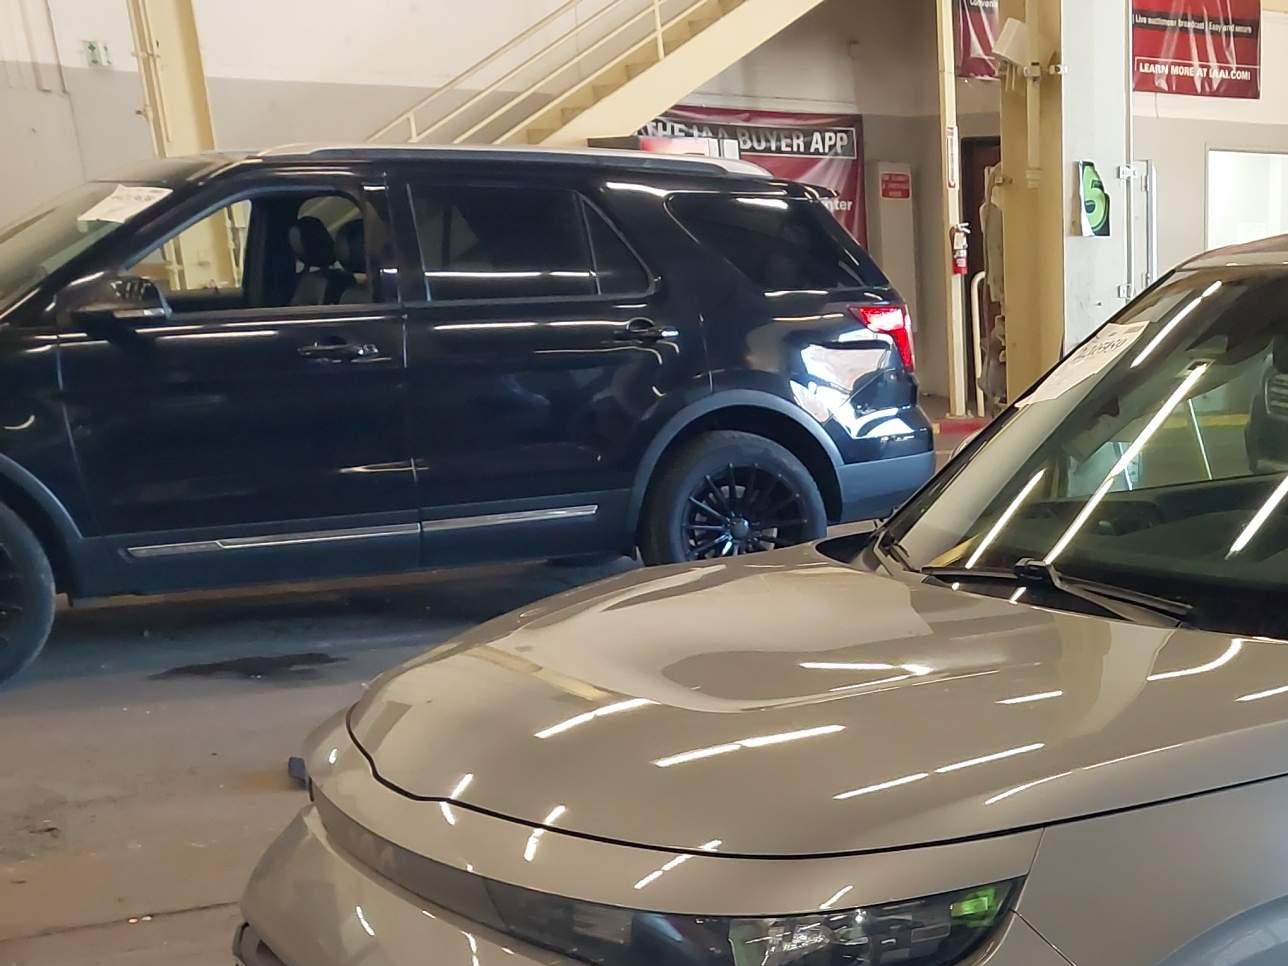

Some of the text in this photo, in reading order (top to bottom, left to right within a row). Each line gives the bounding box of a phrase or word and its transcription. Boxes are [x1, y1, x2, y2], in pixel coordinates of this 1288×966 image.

[1135, 14, 1147, 25] Live
[1139, 62, 1169, 75] LEARN
[1170, 64, 1195, 77] MORE
[1196, 67, 1209, 79] AT
[736, 127, 805, 153] BUYER
[808, 131, 849, 154] APP
